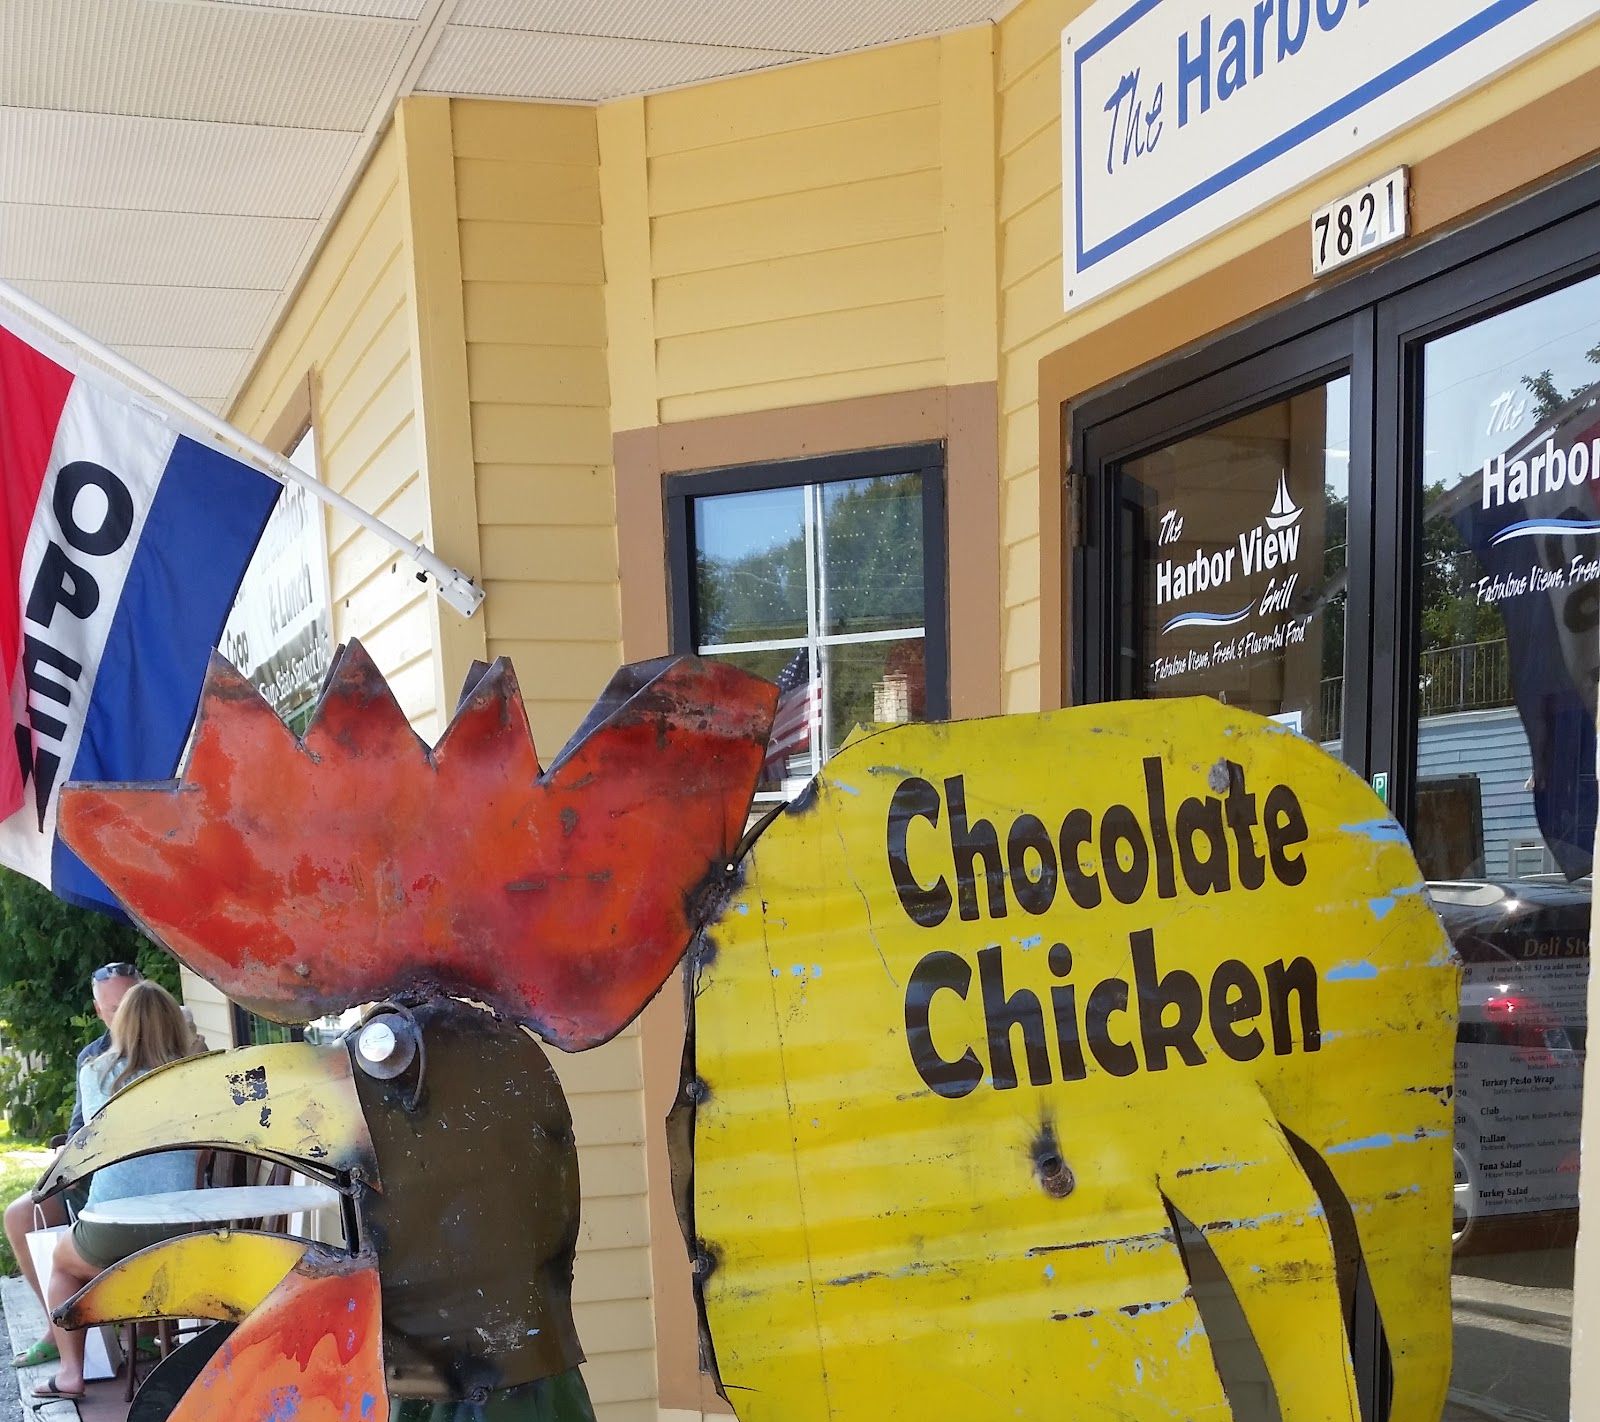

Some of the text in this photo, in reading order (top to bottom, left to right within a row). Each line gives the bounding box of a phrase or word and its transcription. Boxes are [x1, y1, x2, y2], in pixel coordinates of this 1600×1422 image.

[1104, 0, 1369, 174] The Harb
[1314, 179, 1396, 265] 7821
[1487, 389, 1527, 436] The
[1158, 509, 1184, 546] The
[1156, 524, 1301, 605] Harbor View
[1529, 565, 1565, 593] Views,
[1258, 572, 1299, 616] Grill
[1212, 637, 1236, 666] Fresh
[1245, 624, 1285, 658] Flavorful
[886, 756, 1322, 1100] Chocolate Chicken
[1523, 936, 1561, 957] Deli
[1481, 1078, 1508, 1088] Turkey
[1534, 1073, 1555, 1085] Wrap
[1480, 1106, 1500, 1116] Club
[1479, 1134, 1506, 1143] Italian
[1479, 1160, 1522, 1170] Tuna Salad
[1479, 1186, 1529, 1199] Turkey Salad
